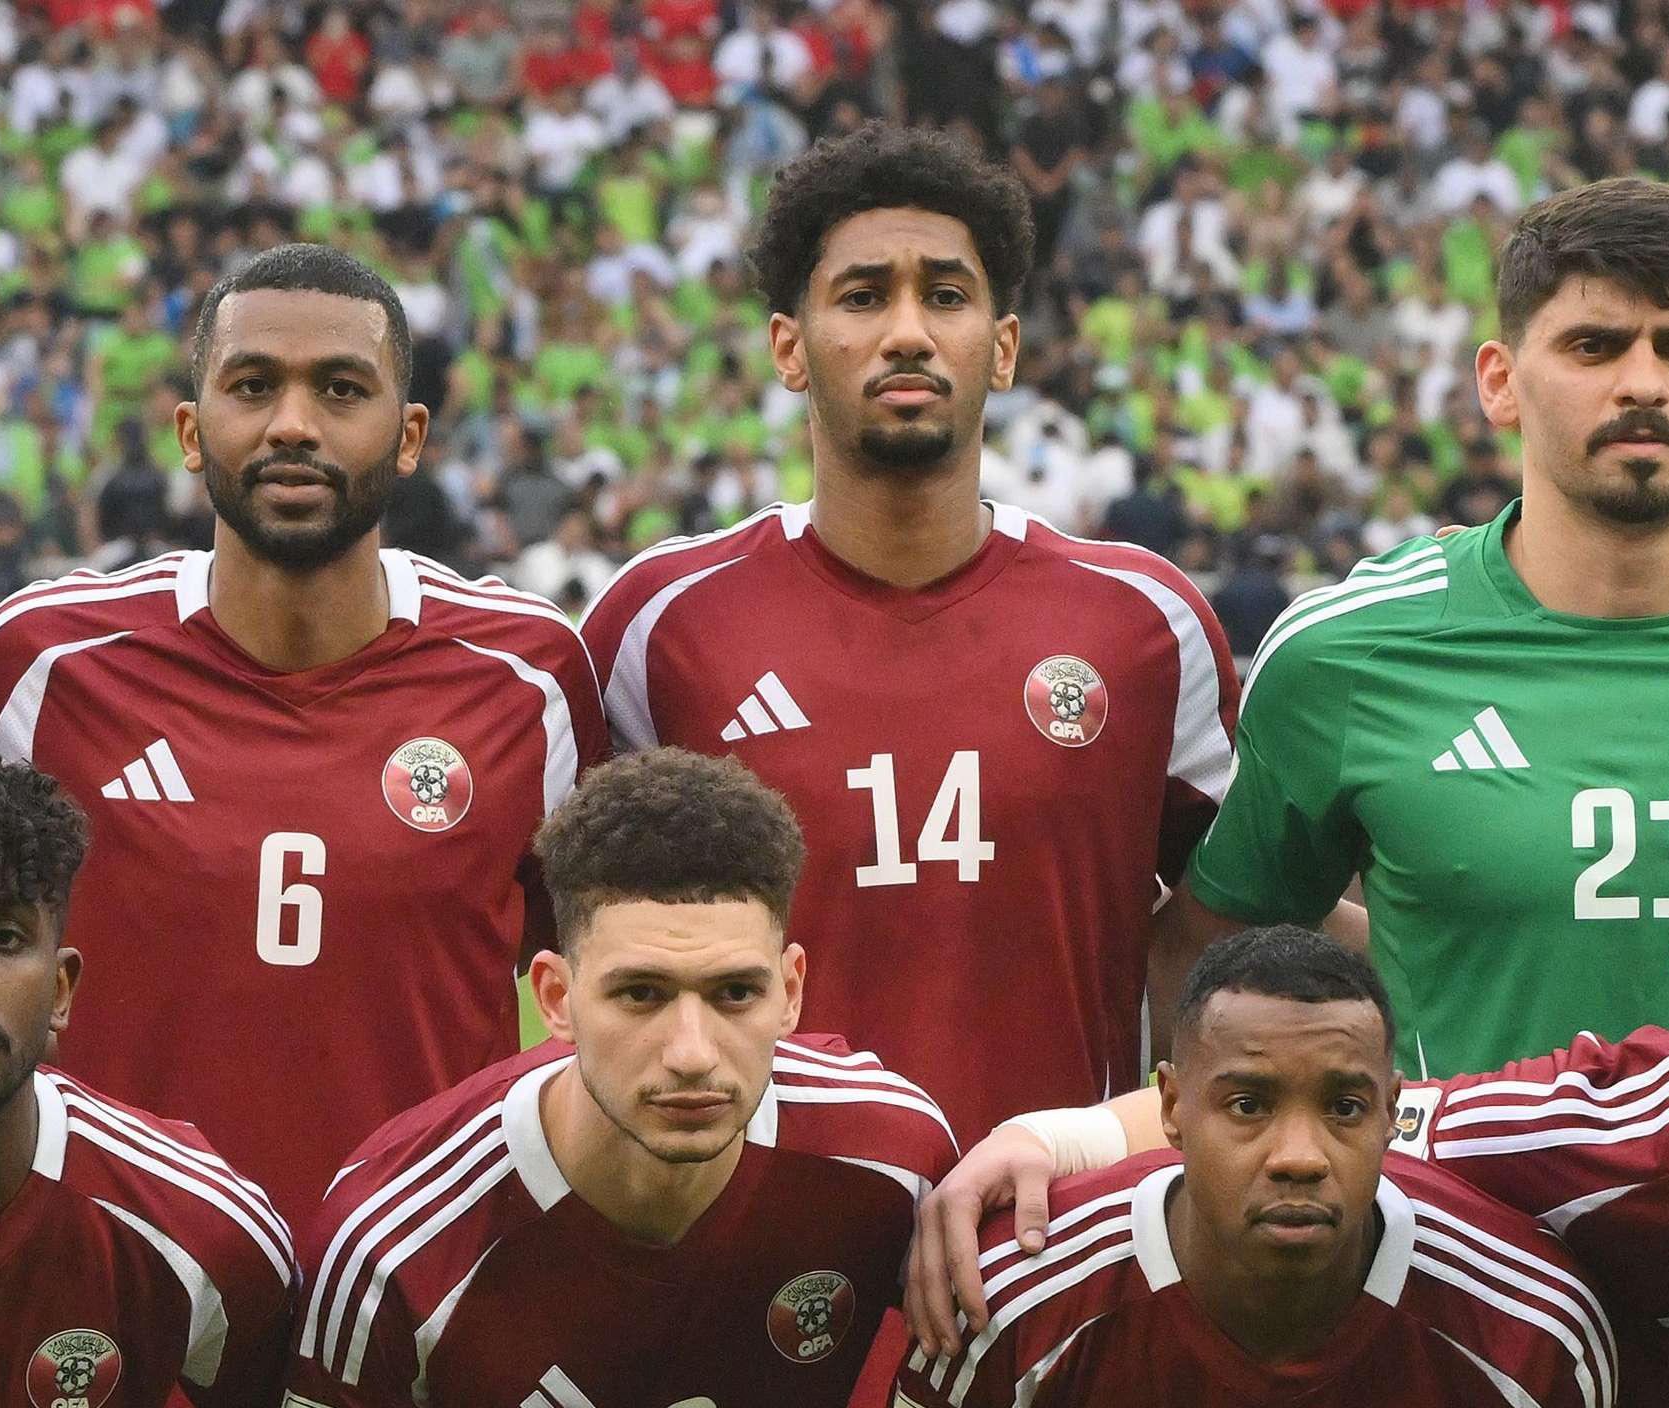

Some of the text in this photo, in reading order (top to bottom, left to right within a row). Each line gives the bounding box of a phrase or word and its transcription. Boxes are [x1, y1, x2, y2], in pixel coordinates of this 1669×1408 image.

[1049, 720, 1085, 741] QFA
[411, 805, 449, 824] QFA
[846, 750, 996, 888] 14
[256, 831, 327, 967] 6
[797, 1333, 834, 1357] QFA
